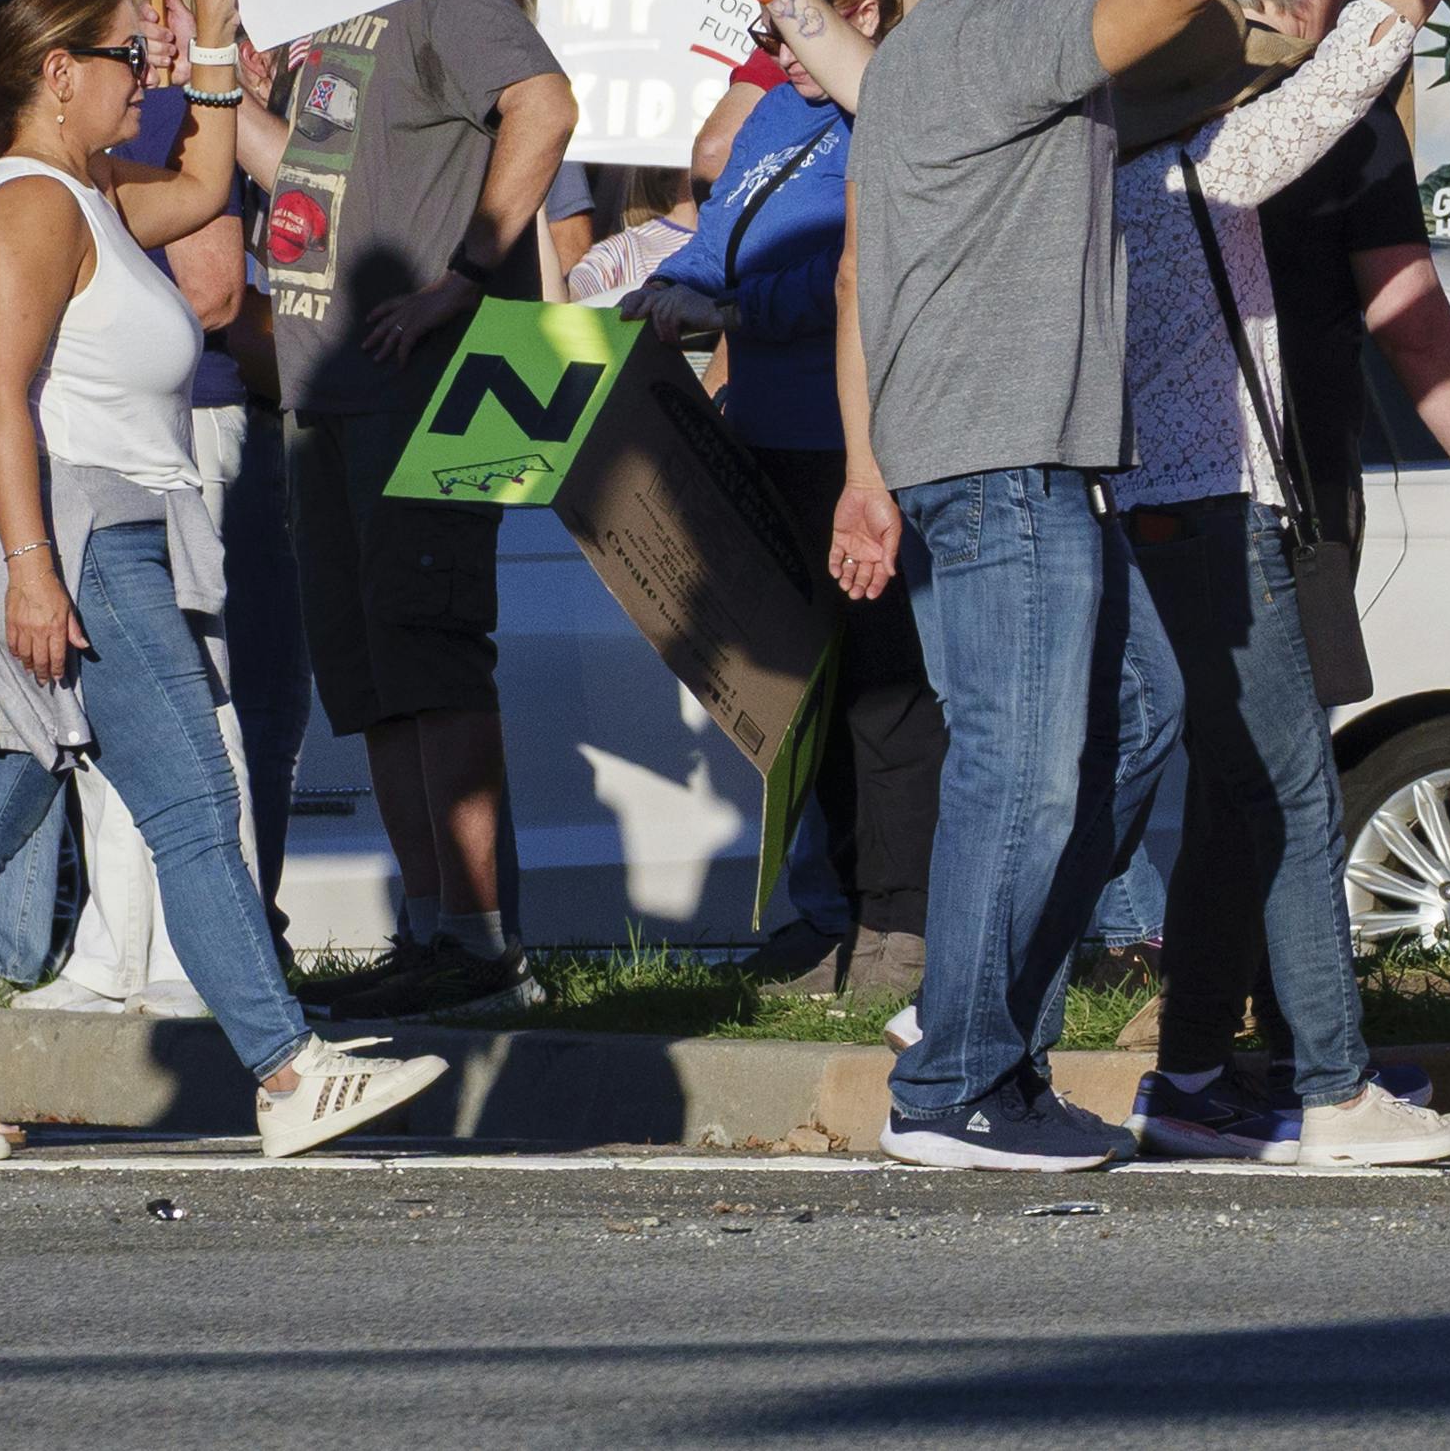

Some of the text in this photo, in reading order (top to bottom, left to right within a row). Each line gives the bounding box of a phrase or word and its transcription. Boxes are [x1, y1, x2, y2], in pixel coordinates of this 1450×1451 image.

[277, 288, 331, 322] HAT
[427, 352, 607, 444] N
[602, 525, 660, 604] Create
